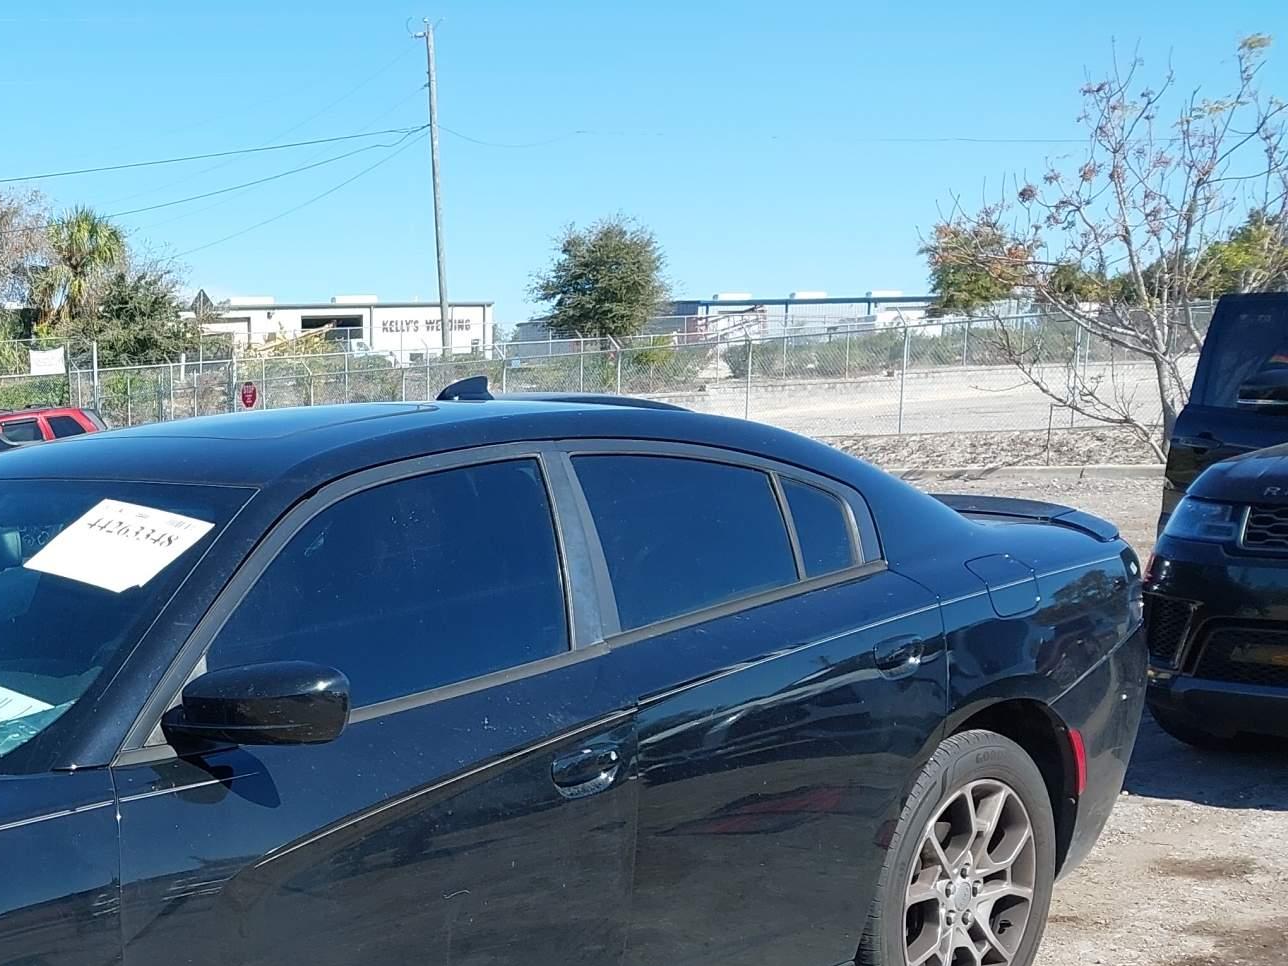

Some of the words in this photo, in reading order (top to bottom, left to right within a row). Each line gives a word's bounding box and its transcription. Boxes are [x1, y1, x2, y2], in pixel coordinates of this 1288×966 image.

[382, 319, 419, 333] KELLY'S
[425, 318, 471, 332] WEDING
[87, 517, 179, 547] 44263348
